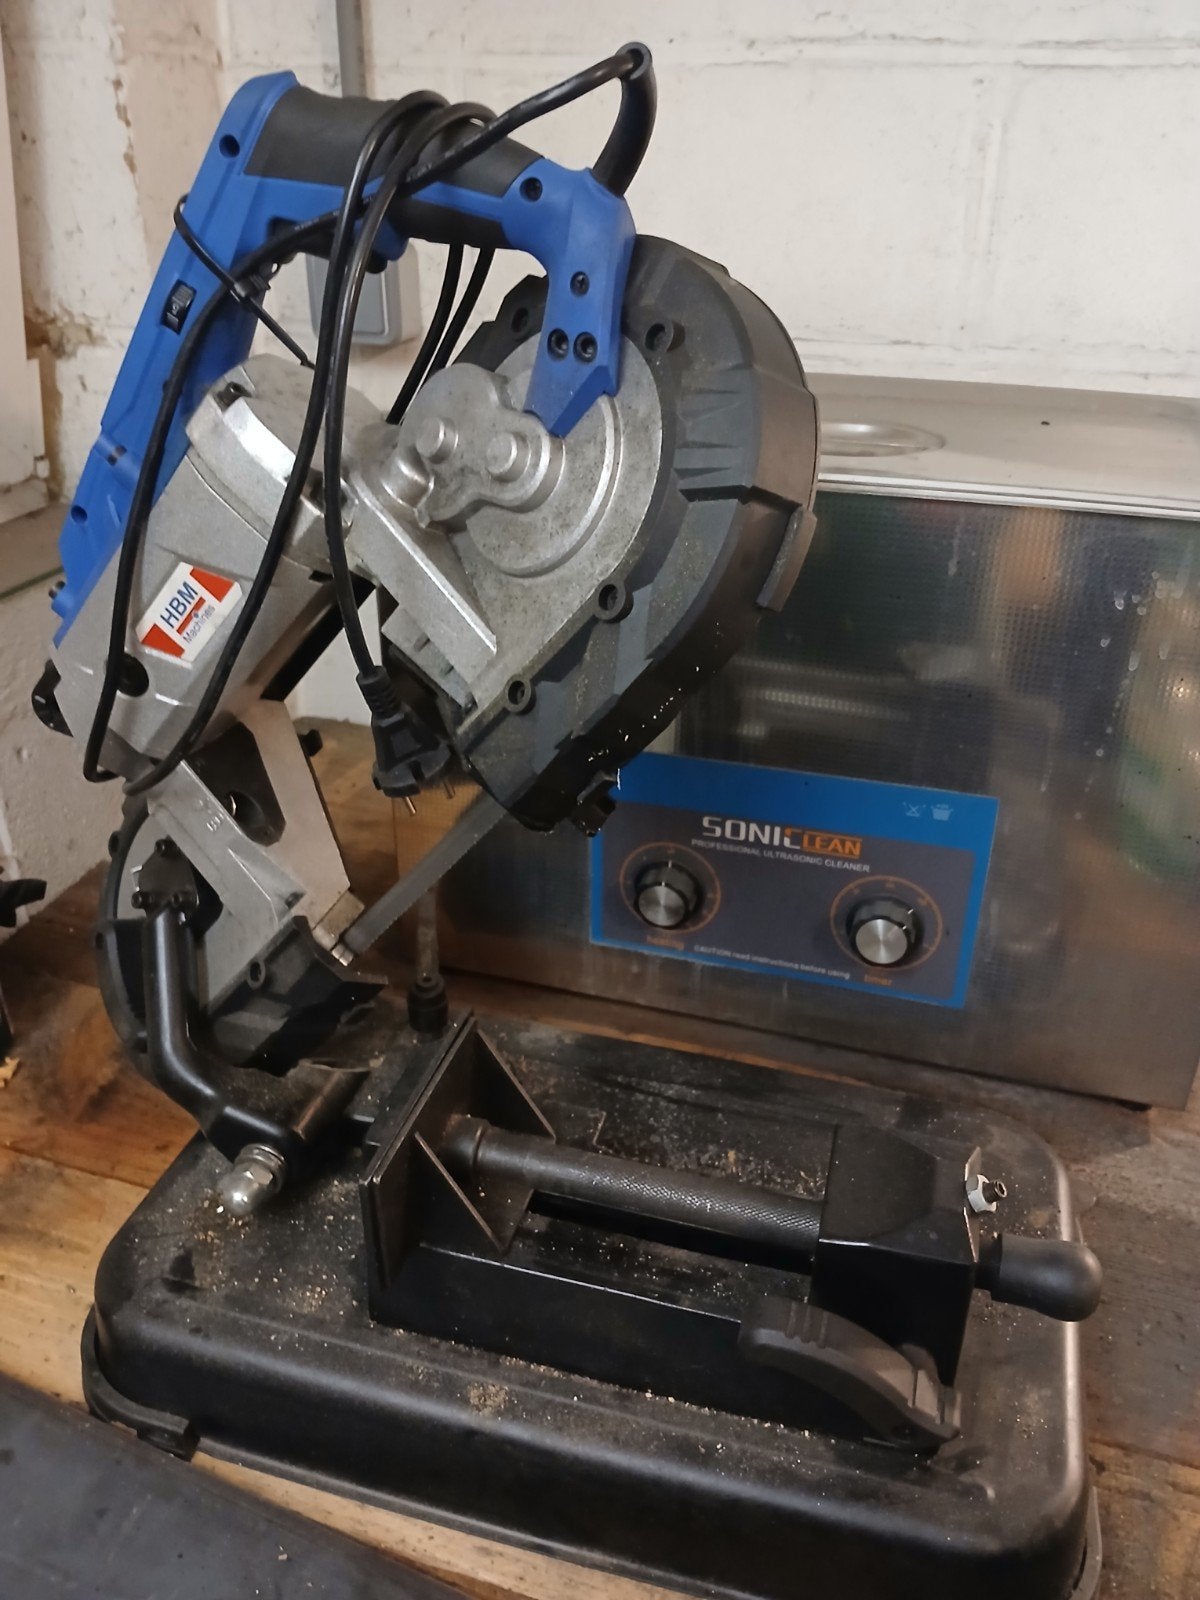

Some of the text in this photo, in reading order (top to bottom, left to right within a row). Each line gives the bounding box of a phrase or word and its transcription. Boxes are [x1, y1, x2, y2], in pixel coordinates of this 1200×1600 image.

[160, 581, 198, 629] HBM
[182, 604, 216, 644] Machines
[691, 838, 870, 873] PROFESSIONAL ULTRASONIC CLEANER
